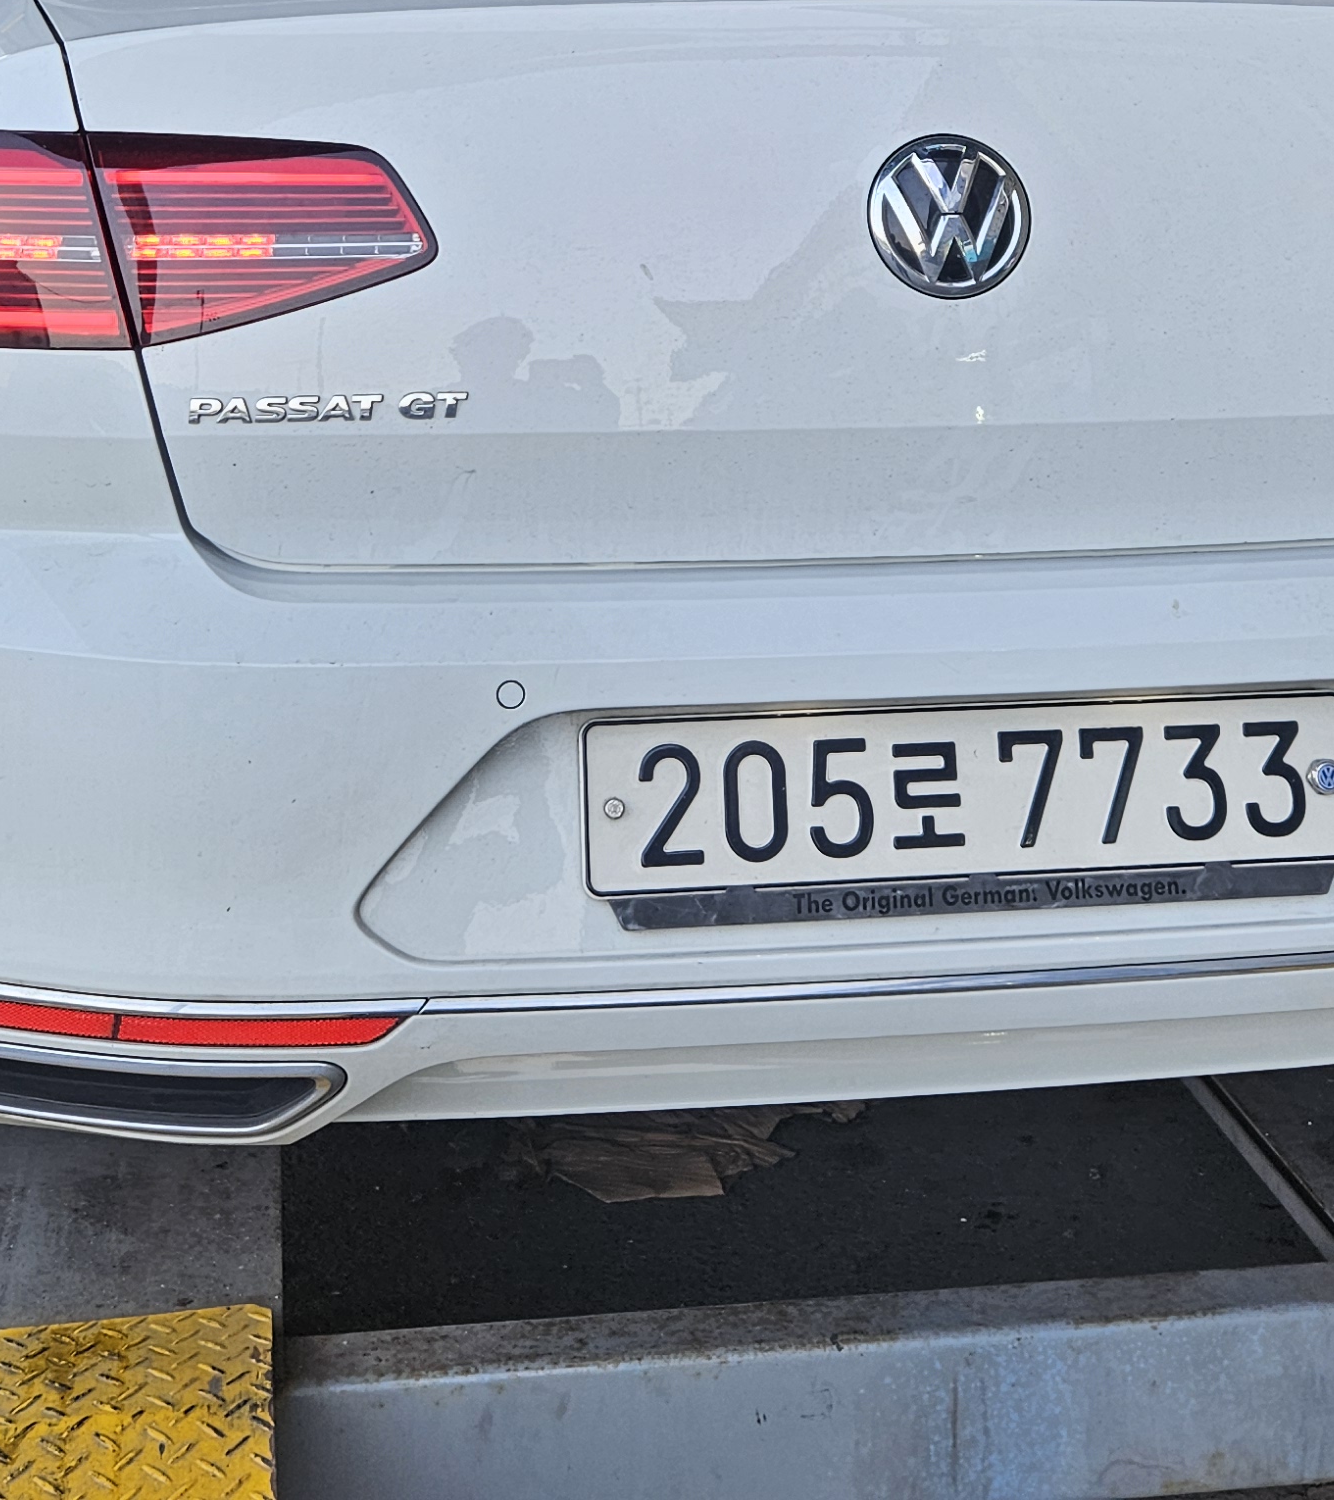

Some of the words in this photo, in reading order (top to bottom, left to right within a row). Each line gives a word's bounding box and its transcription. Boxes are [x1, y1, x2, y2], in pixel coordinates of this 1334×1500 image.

[188, 393, 384, 424] PASSAT
[398, 391, 469, 421] GT
[637, 738, 965, 868] 205로
[997, 720, 1307, 848] 7733
[793, 892, 834, 916] The
[841, 885, 934, 918] Original
[1045, 878, 1188, 905] Volkswagen.
